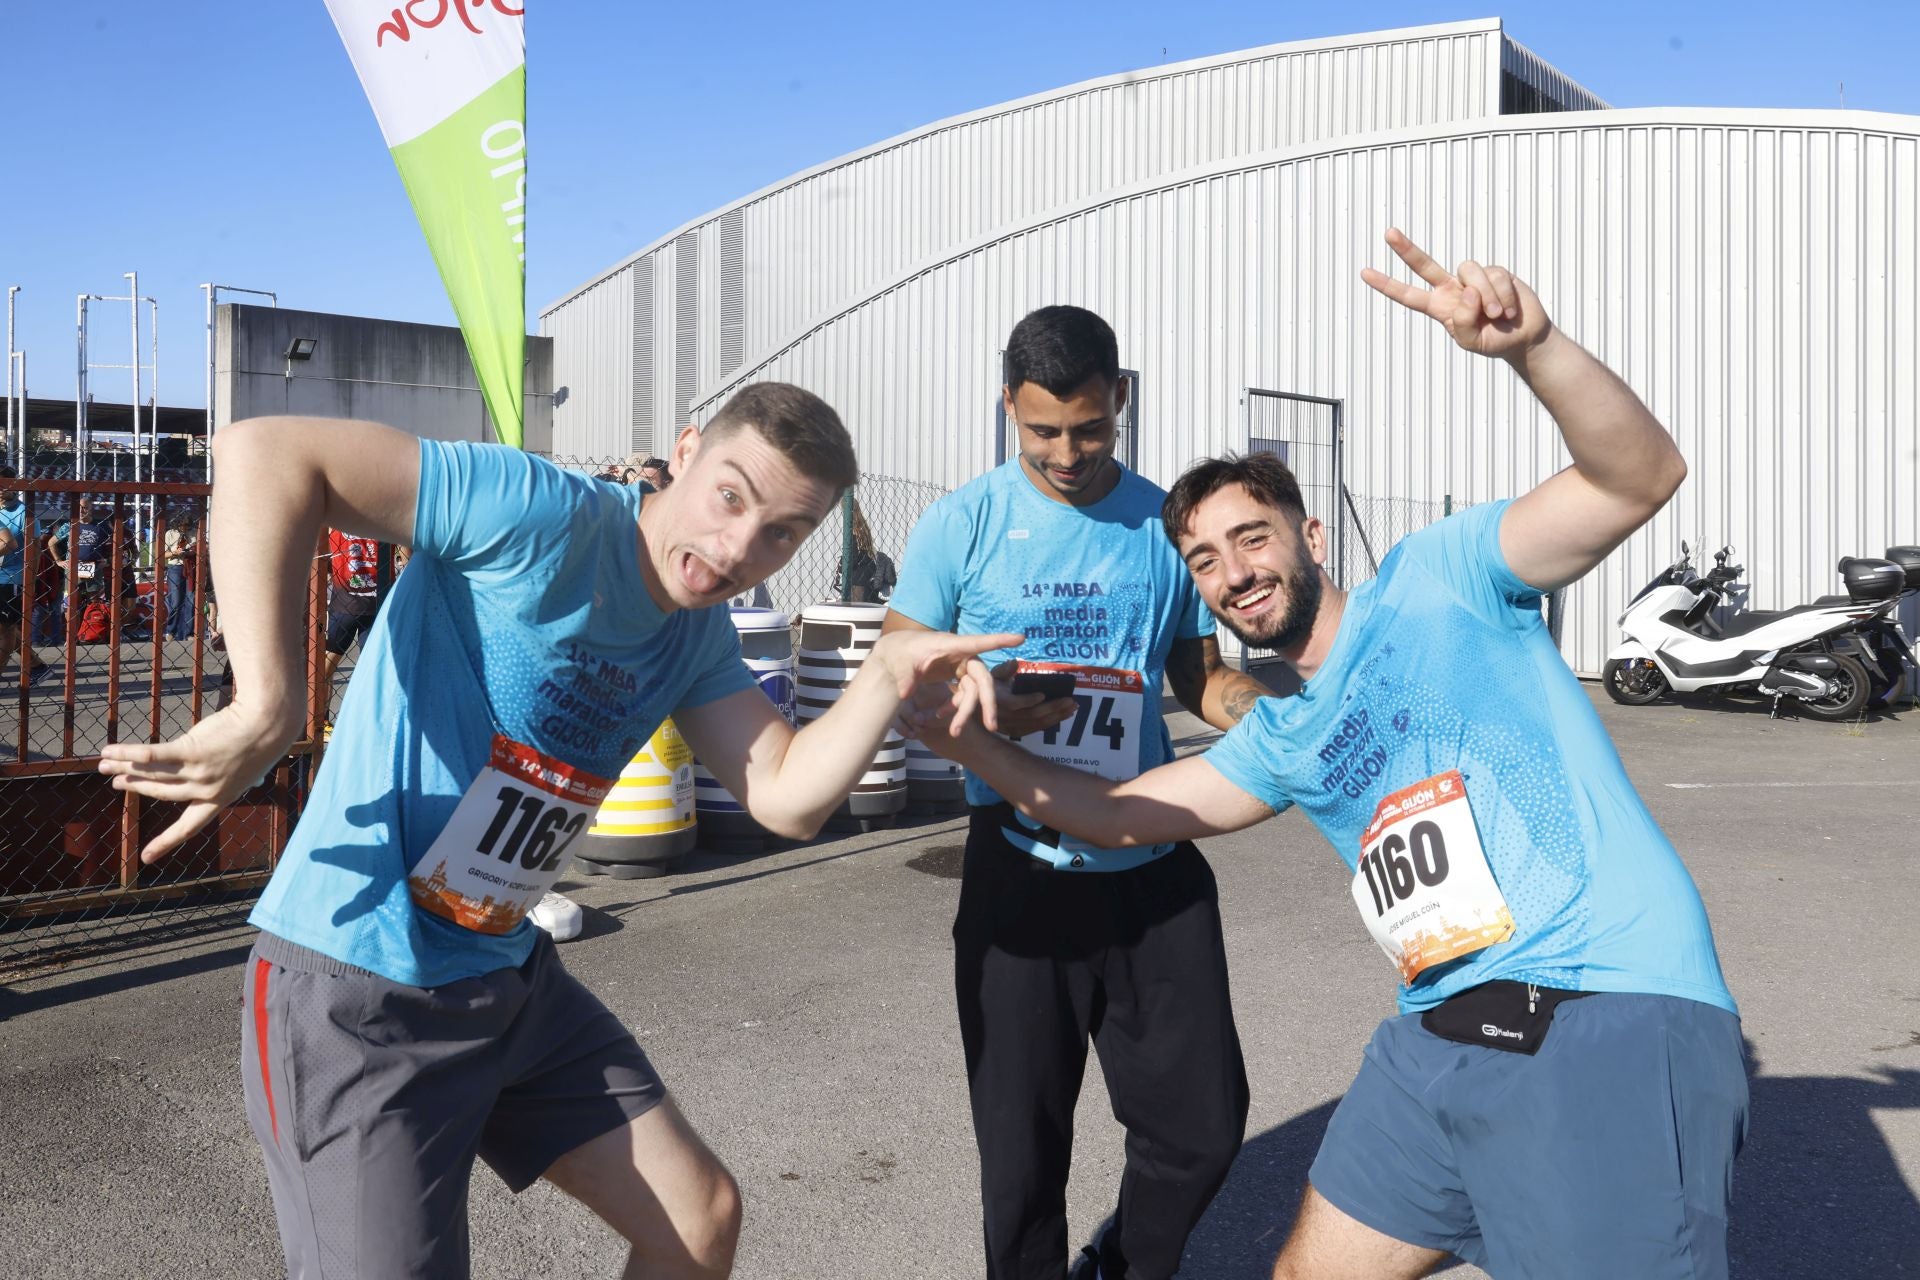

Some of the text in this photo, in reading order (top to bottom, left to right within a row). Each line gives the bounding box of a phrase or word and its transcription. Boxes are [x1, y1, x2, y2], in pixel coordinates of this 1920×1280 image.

[1022, 583, 1050, 598] 14ª
[1053, 582, 1104, 597] MBA
[1044, 604, 1107, 621] media
[1024, 621, 1109, 639] maratón
[1044, 638, 1109, 660] GIJÓN
[597, 660, 638, 694] MBA
[1091, 674, 1120, 685] GIJÓN
[572, 671, 628, 718] media
[1318, 708, 1369, 764] media
[1073, 756, 1100, 767] BRAVO
[538, 767, 572, 791] MBA
[1401, 787, 1435, 811] GIJÓN
[475, 786, 588, 872] 1162
[467, 866, 508, 888] GRIGORIY
[1360, 820, 1450, 919] 1160
[1399, 910, 1421, 926] MIGUEL
